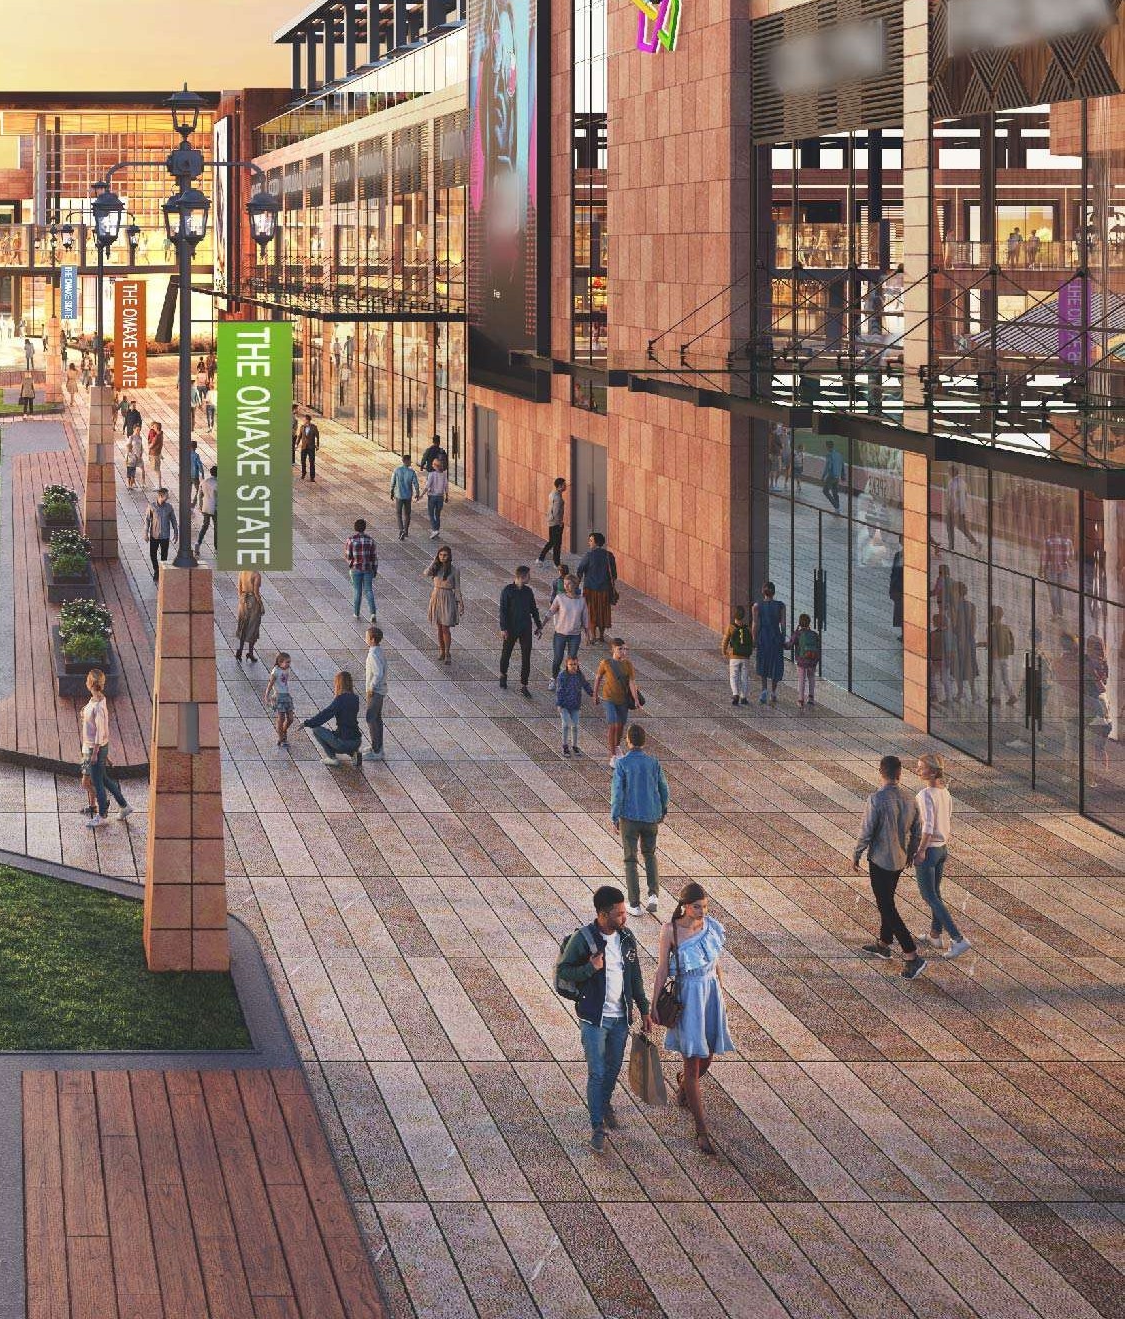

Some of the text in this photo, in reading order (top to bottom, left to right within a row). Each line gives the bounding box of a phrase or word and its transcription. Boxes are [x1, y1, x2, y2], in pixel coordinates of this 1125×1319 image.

[122, 283, 138, 387] THE OMAXE STATE
[236, 327, 271, 565] THE OMAXE STATE
